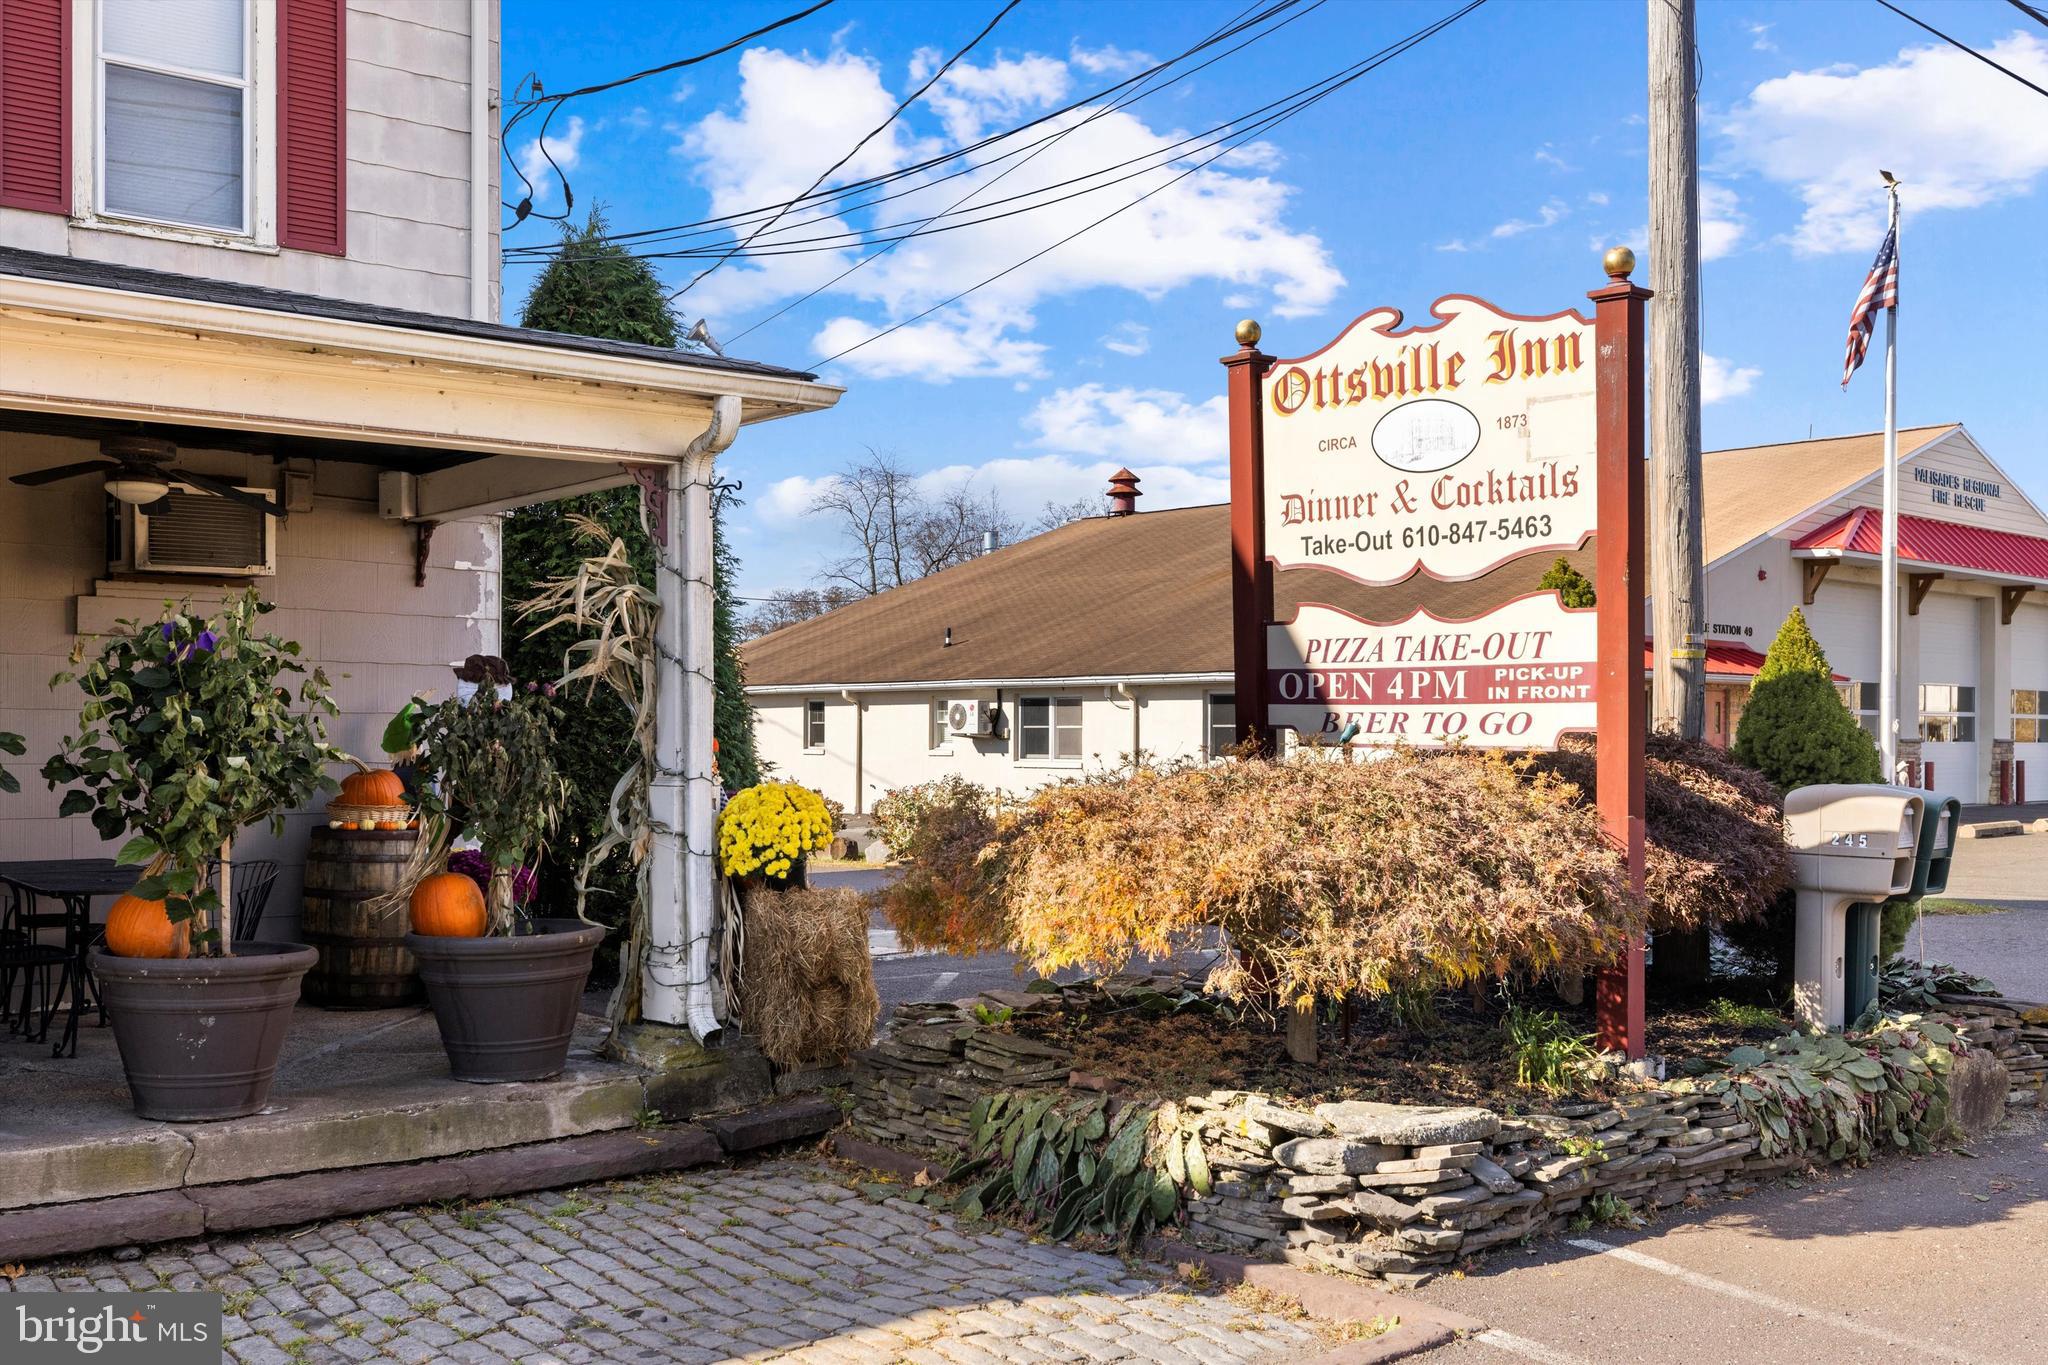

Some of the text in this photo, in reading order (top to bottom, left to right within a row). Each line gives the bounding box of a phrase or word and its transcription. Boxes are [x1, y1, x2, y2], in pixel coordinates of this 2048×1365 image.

[1271, 327, 1584, 417] Ottsville Inn
[1496, 414, 1528, 430] 1873
[1318, 436, 1357, 453] CIRCA
[1281, 461, 1579, 527] Dinner & Cocktails
[1914, 467, 2000, 498] PALISADES REGIONAL
[1932, 488, 1986, 512] FIRE RESCUE
[1301, 514, 1553, 557] Take-Out 610-847-5463
[1713, 624, 1741, 635] STATION
[1744, 627, 1753, 637] 49
[1304, 631, 1552, 664] PIZZA TAKE-OUT
[1279, 671, 1376, 700] OPEN
[1495, 666, 1584, 681] PICK-UP
[1488, 685, 1591, 699] IN FRONT
[1423, 711, 1467, 735] TO
[1480, 711, 1532, 735] GO
